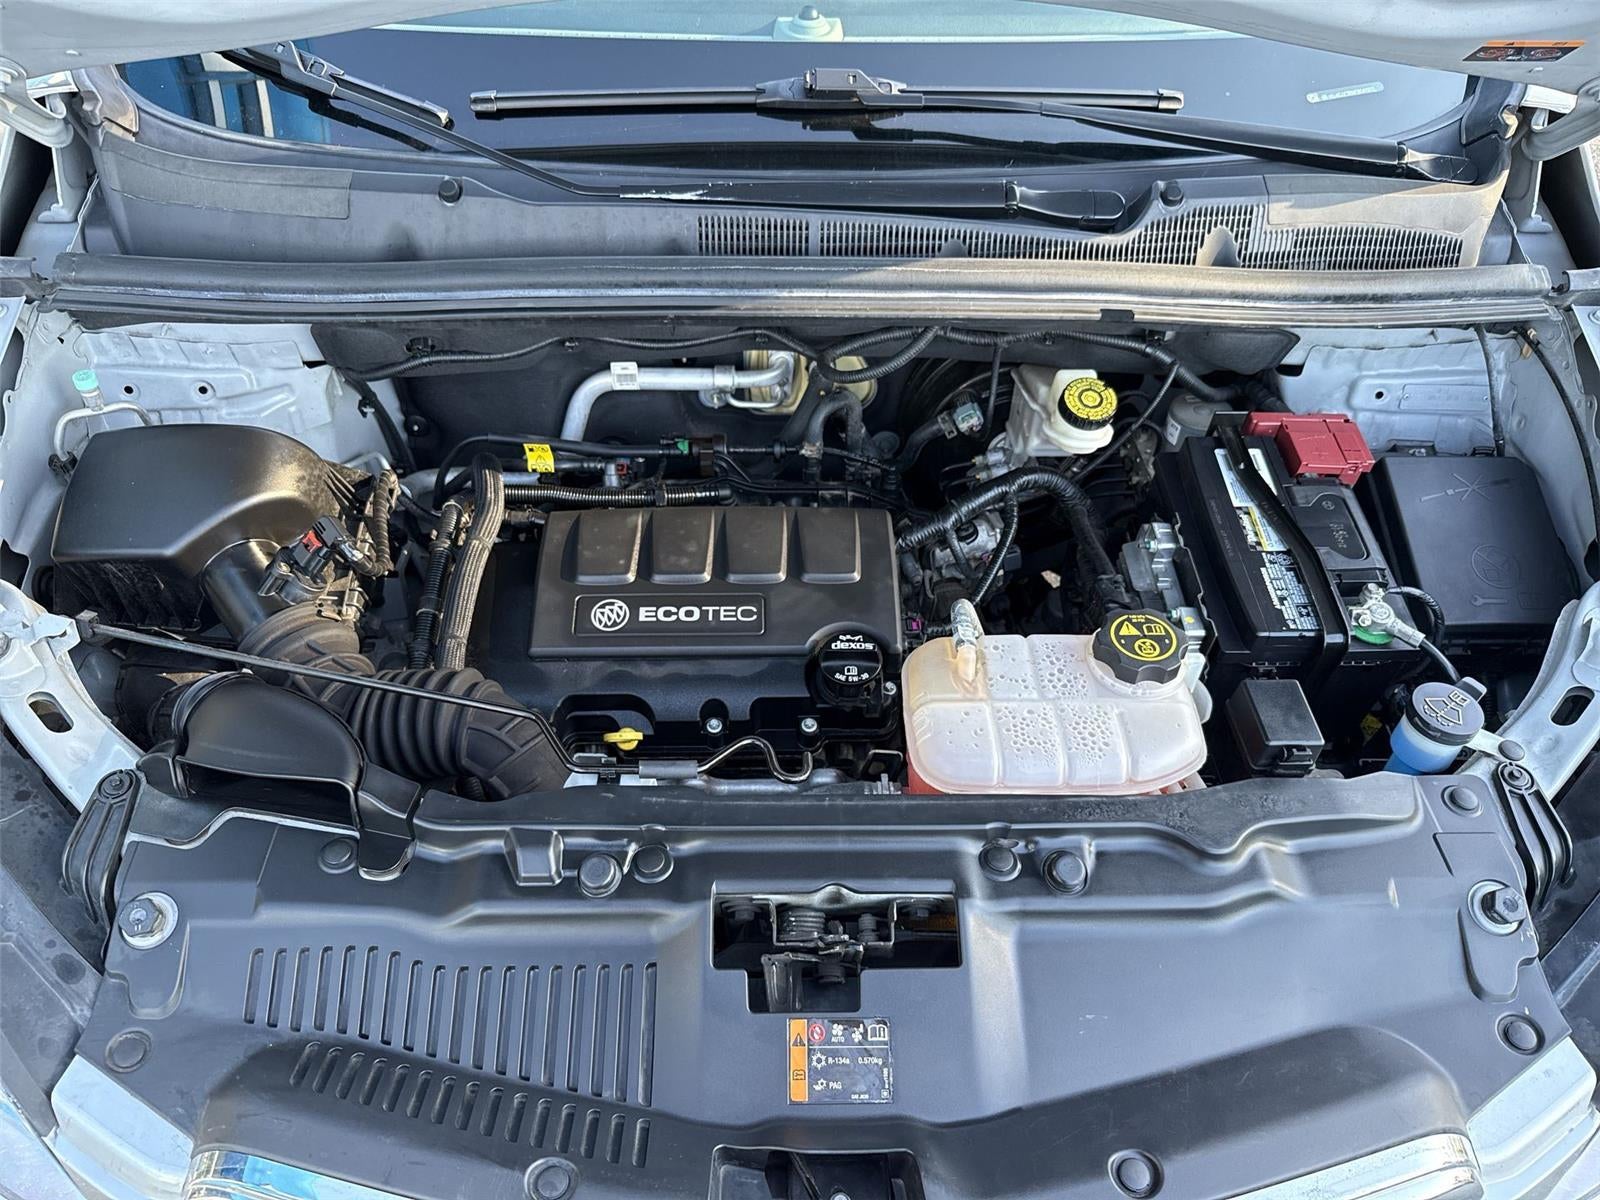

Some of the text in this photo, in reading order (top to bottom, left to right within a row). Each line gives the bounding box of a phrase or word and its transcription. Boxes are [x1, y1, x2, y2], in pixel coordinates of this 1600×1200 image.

[638, 606, 758, 622] ECOTEC
[831, 640, 875, 650] dexos
[834, 672, 869, 682] SAE 5W-30
[827, 1056, 883, 1066] R-134a 0.570kg
[829, 1081, 842, 1089] PAG
